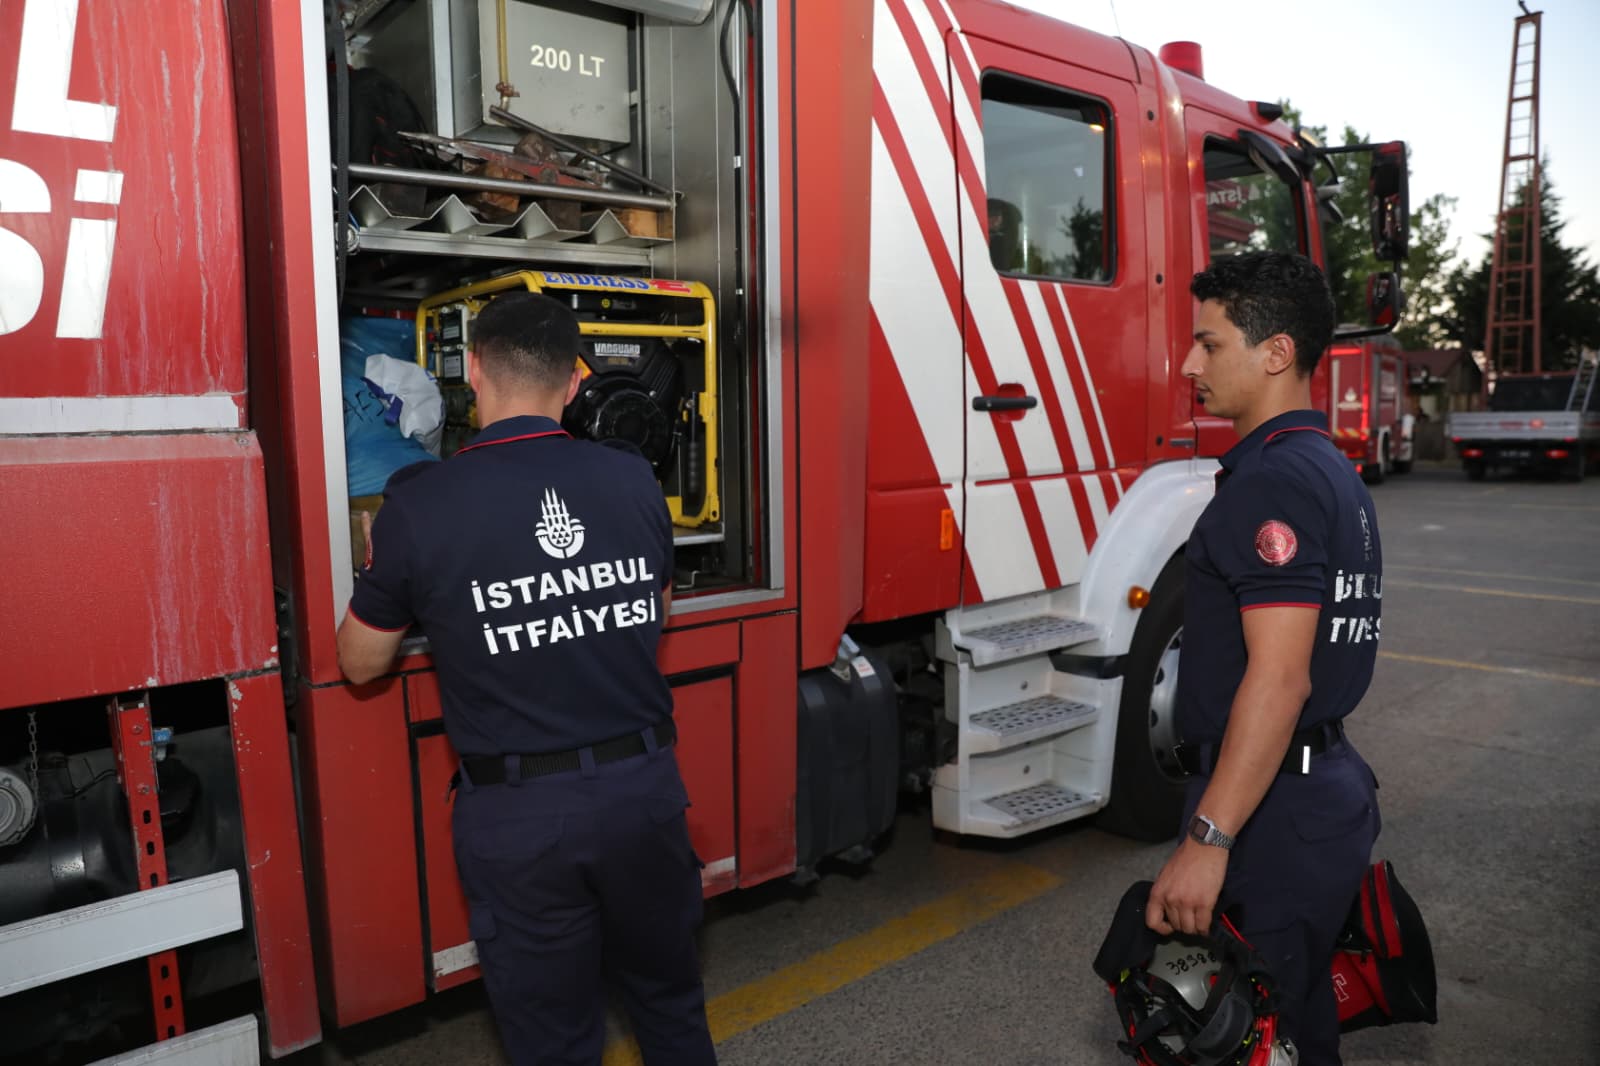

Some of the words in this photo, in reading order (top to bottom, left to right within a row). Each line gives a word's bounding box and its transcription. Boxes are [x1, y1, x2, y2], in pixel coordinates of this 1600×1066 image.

[530, 44, 572, 72] 200
[579, 53, 605, 78] LT
[543, 271, 649, 290] ENDRESS
[471, 557, 654, 613] İSTANBUL
[483, 591, 656, 655] İTFAİYESİ
